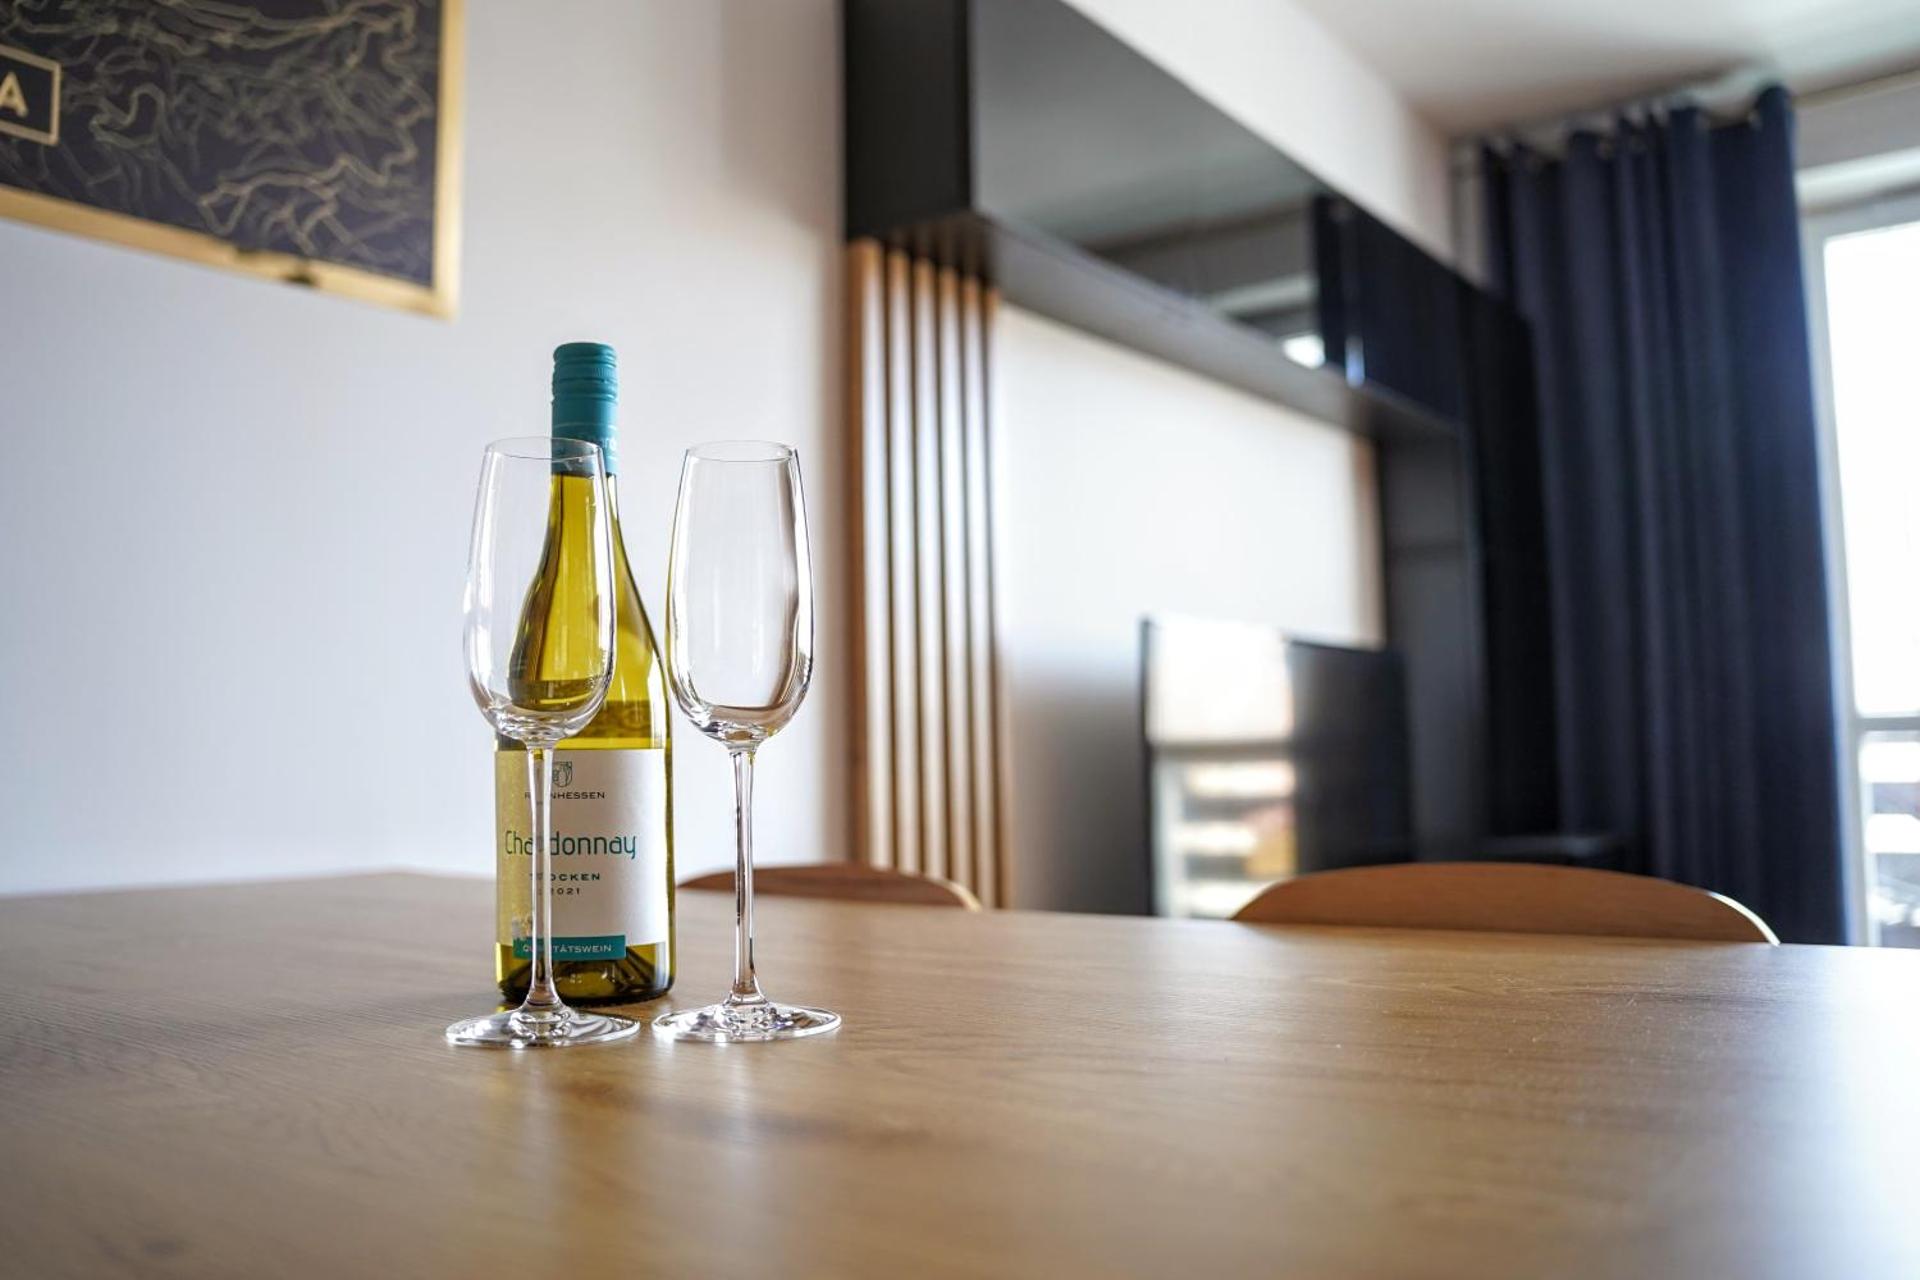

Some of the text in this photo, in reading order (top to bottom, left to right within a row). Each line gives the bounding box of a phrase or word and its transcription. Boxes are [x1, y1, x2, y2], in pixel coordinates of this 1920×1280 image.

[524, 791, 605, 800] RNHESSEN
[505, 830, 636, 860] Chadonnay
[529, 873, 600, 881] OCKEN
